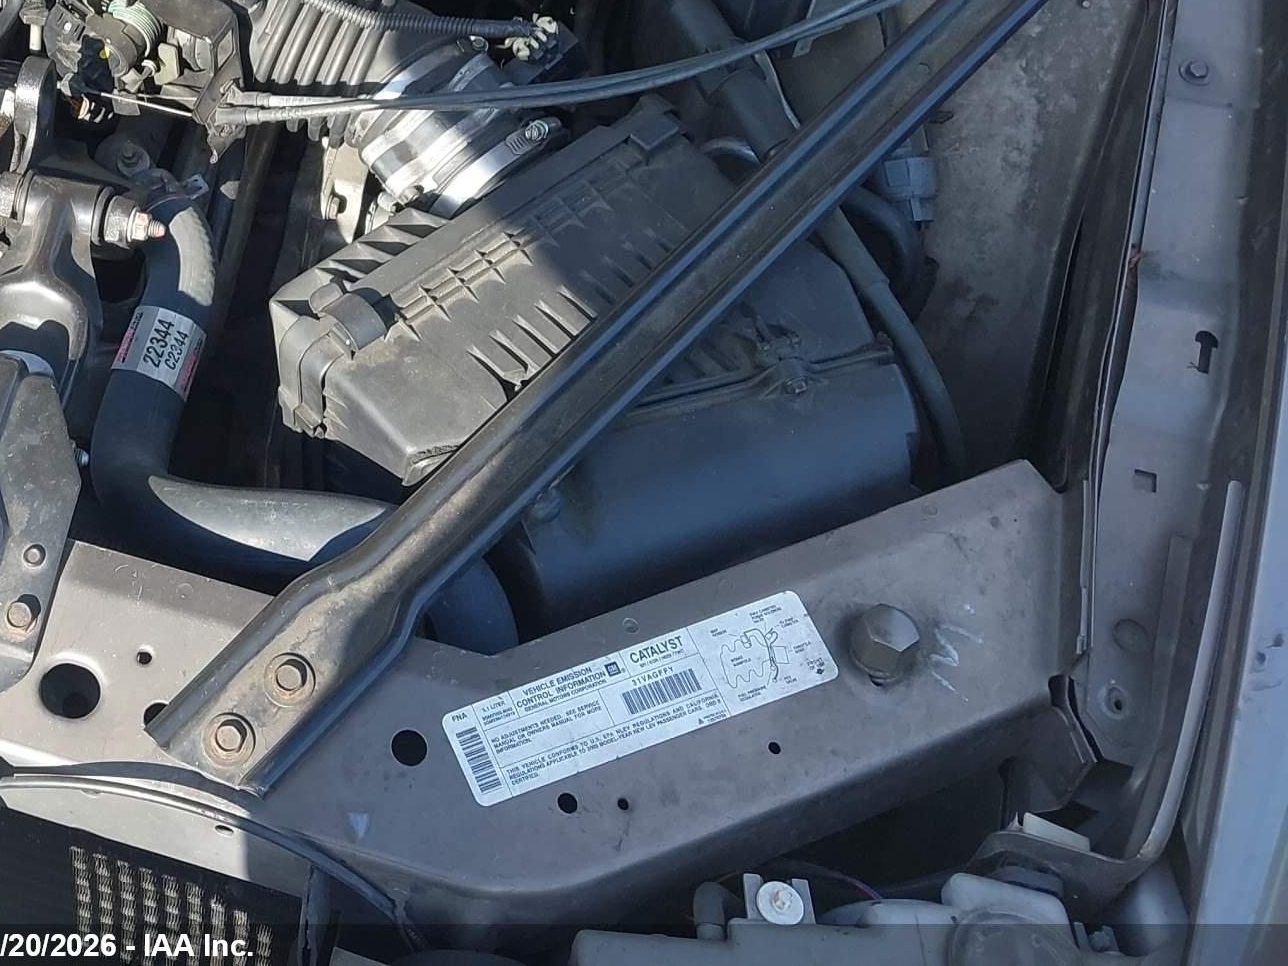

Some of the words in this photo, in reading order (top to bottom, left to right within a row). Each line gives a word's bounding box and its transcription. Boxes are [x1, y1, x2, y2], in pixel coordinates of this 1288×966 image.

[143, 319, 175, 369] 22344
[165, 331, 189, 371] C2344
[628, 635, 684, 663] CATALYST
[515, 689, 552, 707] CONTROL
[554, 670, 606, 693] INFORMATION
[522, 680, 555, 696] VEHICLE
[555, 666, 592, 684] EMISSION
[451, 712, 467, 722] FNA
[523, 700, 548, 712] GENERAL
[549, 692, 571, 703] MOTORS
